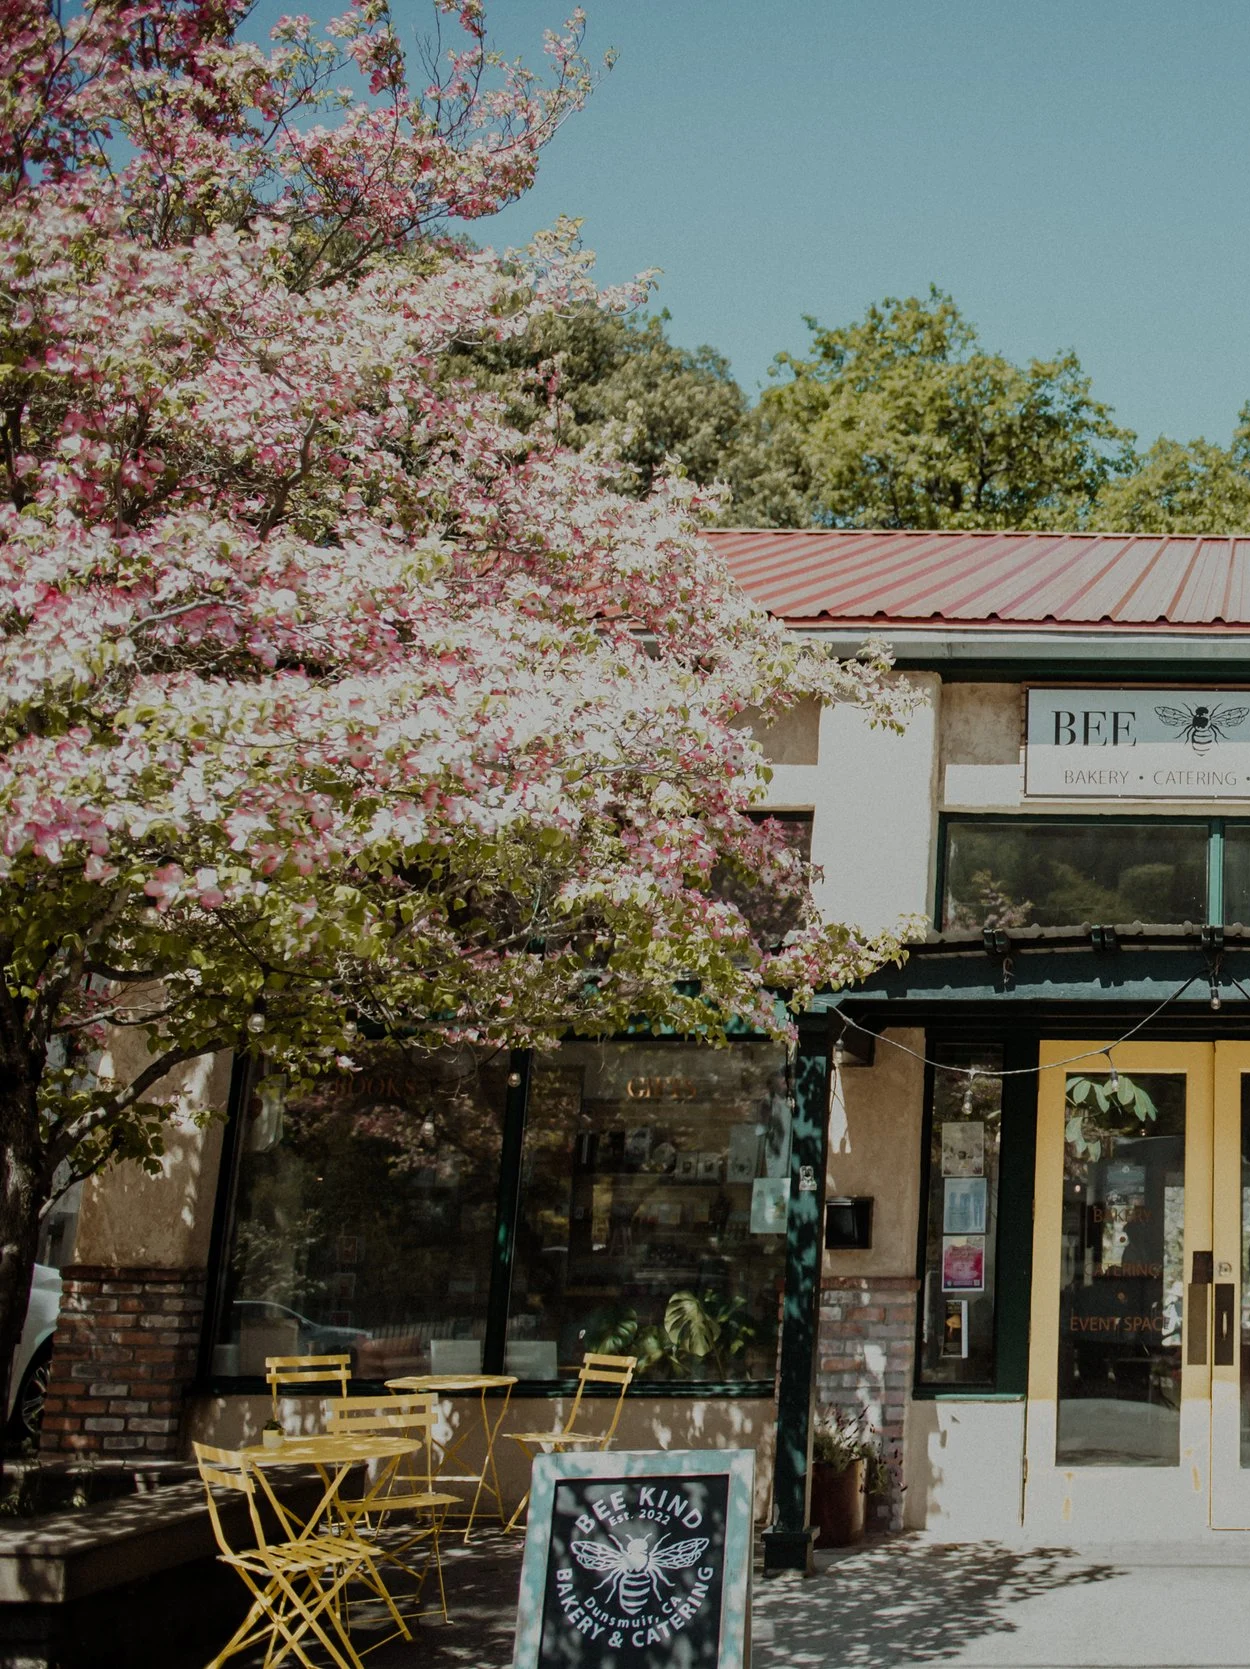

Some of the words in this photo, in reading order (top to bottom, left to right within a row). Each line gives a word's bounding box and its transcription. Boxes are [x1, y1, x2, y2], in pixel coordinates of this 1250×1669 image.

[1051, 710, 1137, 747] BEE
[1064, 769, 1130, 785] BAKERY
[1153, 770, 1237, 786] CATERING
[1093, 1207, 1152, 1223] BAKERY
[1084, 1263, 1162, 1277] CATERING
[1070, 1316, 1117, 1331] EVENT
[1124, 1316, 1171, 1331] SPACE
[575, 1490, 627, 1535] BEE
[639, 1486, 702, 1529] KIND
[608, 1511, 634, 1527] Est.
[639, 1508, 670, 1525] 2022
[556, 1567, 605, 1641] BAKERY
[608, 1630, 623, 1648] &
[632, 1566, 713, 1647] CATERING
[584, 1596, 659, 1628] Dunsmuir,
[661, 1595, 682, 1614] CA
